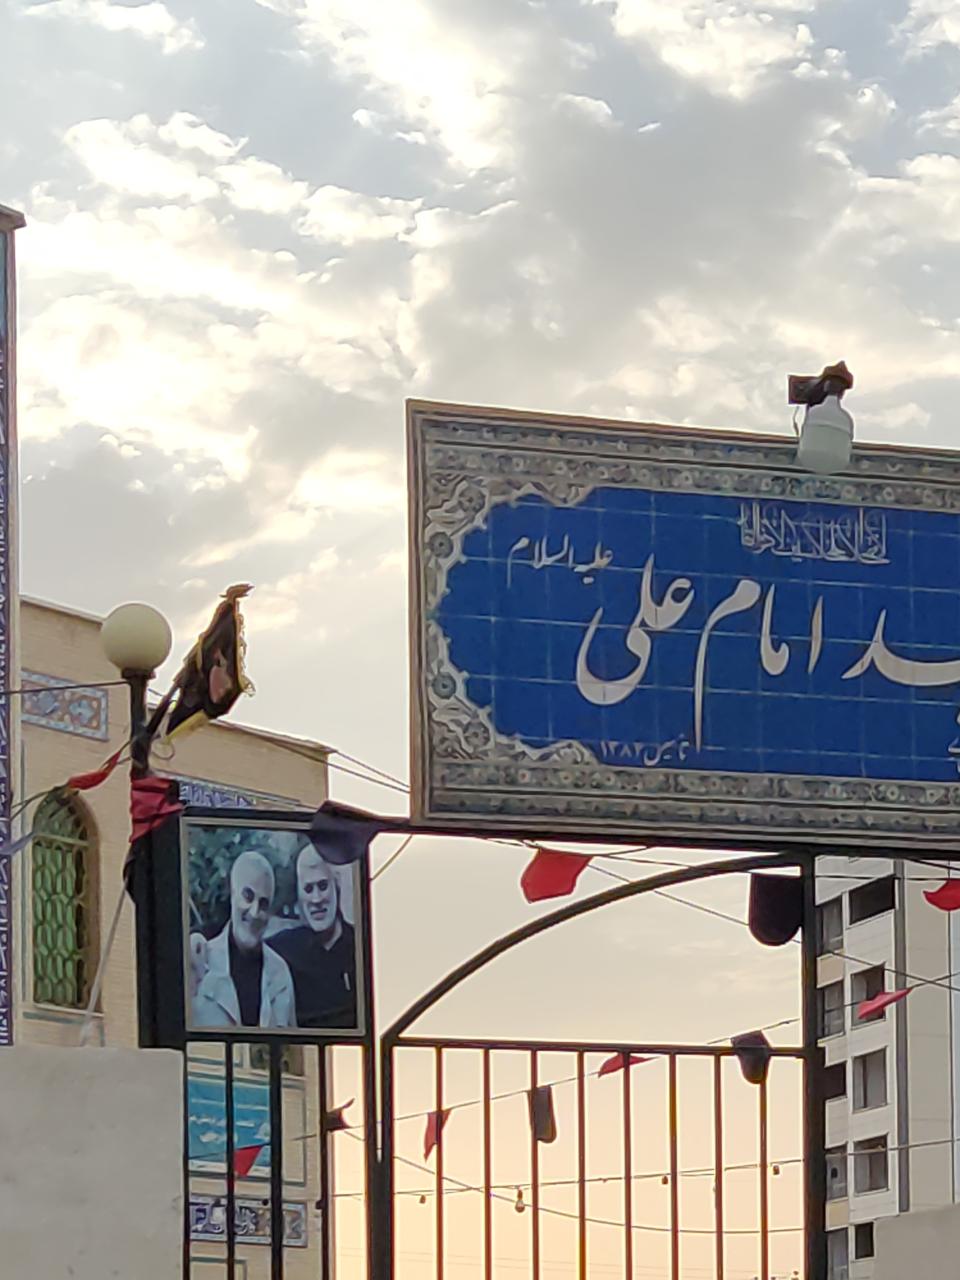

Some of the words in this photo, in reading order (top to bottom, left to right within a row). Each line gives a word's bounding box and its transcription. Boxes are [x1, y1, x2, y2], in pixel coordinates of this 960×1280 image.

[507, 532, 575, 590] السلام
[574, 541, 614, 584] علیه
[576, 553, 695, 706] علی
[695, 577, 823, 752] امام
